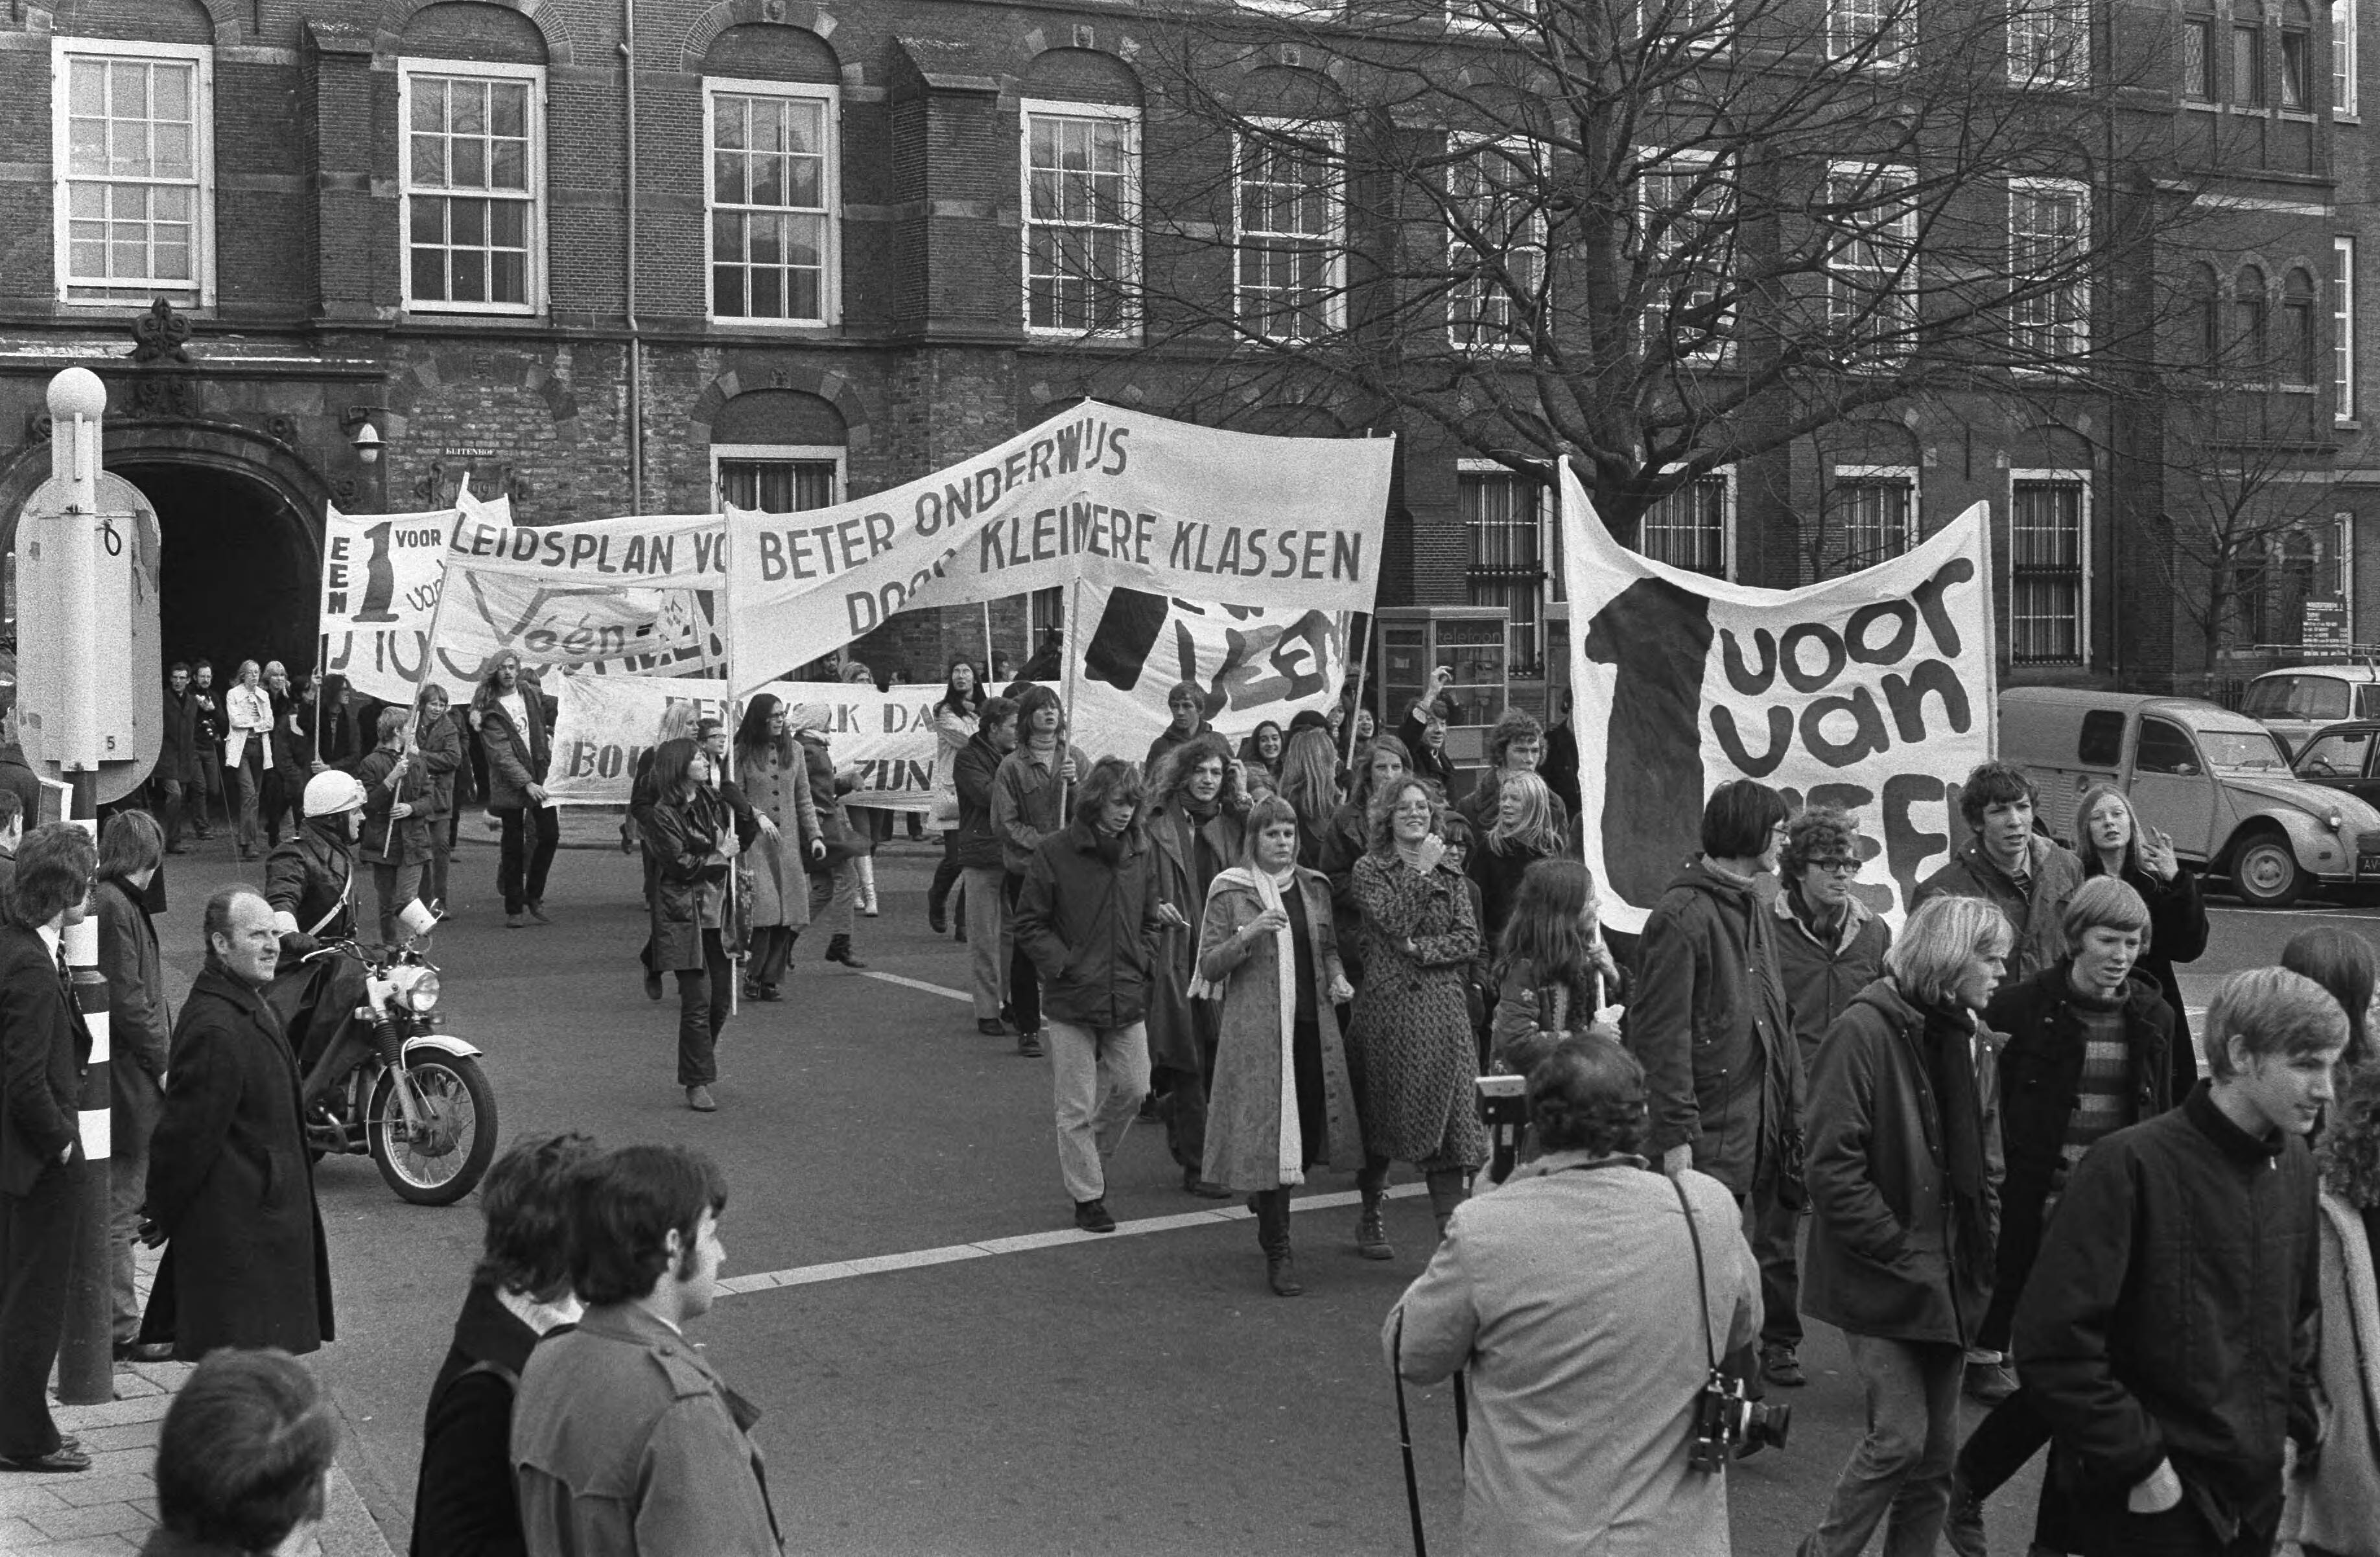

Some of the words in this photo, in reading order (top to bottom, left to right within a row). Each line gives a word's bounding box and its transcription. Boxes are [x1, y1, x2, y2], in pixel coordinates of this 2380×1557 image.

[760, 512, 895, 581] BETER
[915, 417, 1130, 537] ONDERWIJS
[395, 529, 442, 548] VOOR
[980, 501, 1157, 574] KLEINERE
[1170, 521, 1361, 581] KLASSEN
[351, 521, 399, 622] 1
[1437, 626, 1502, 644] telefoon
[106, 735, 115, 750] 5
[1710, 658, 1972, 778] van
[854, 758, 934, 791] ZIJN
